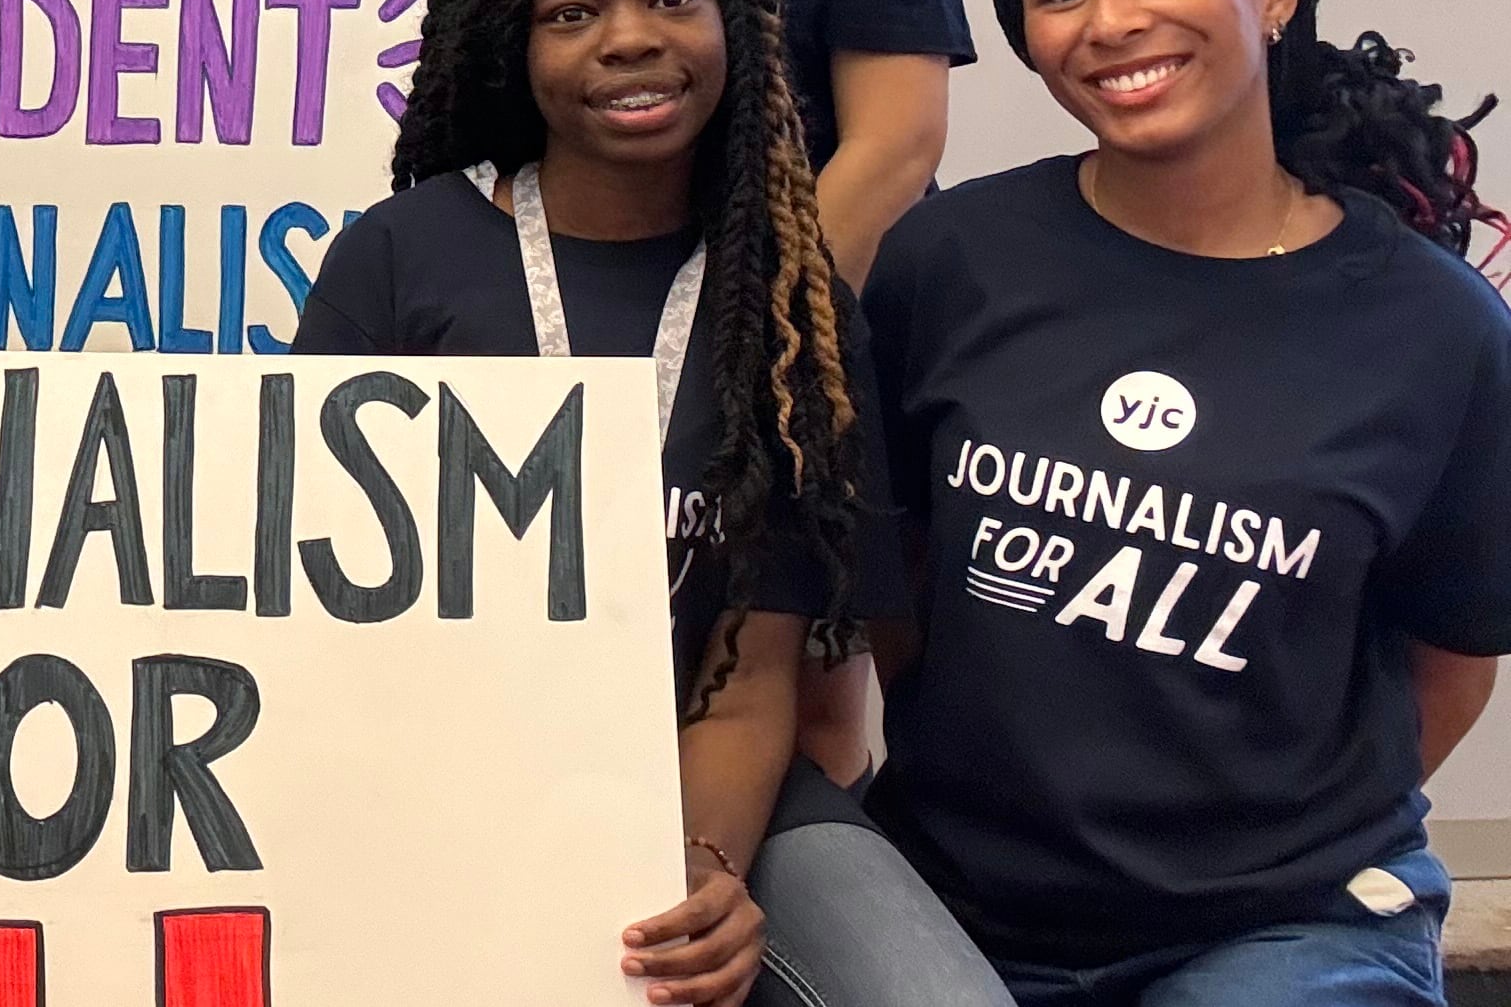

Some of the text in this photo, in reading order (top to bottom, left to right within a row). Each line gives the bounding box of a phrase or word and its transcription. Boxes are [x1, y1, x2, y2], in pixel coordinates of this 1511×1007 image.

[1112, 394, 1184, 430] yjc
[947, 439, 1322, 580] JOURNALISM
[971, 516, 1261, 673] FOR ALL
